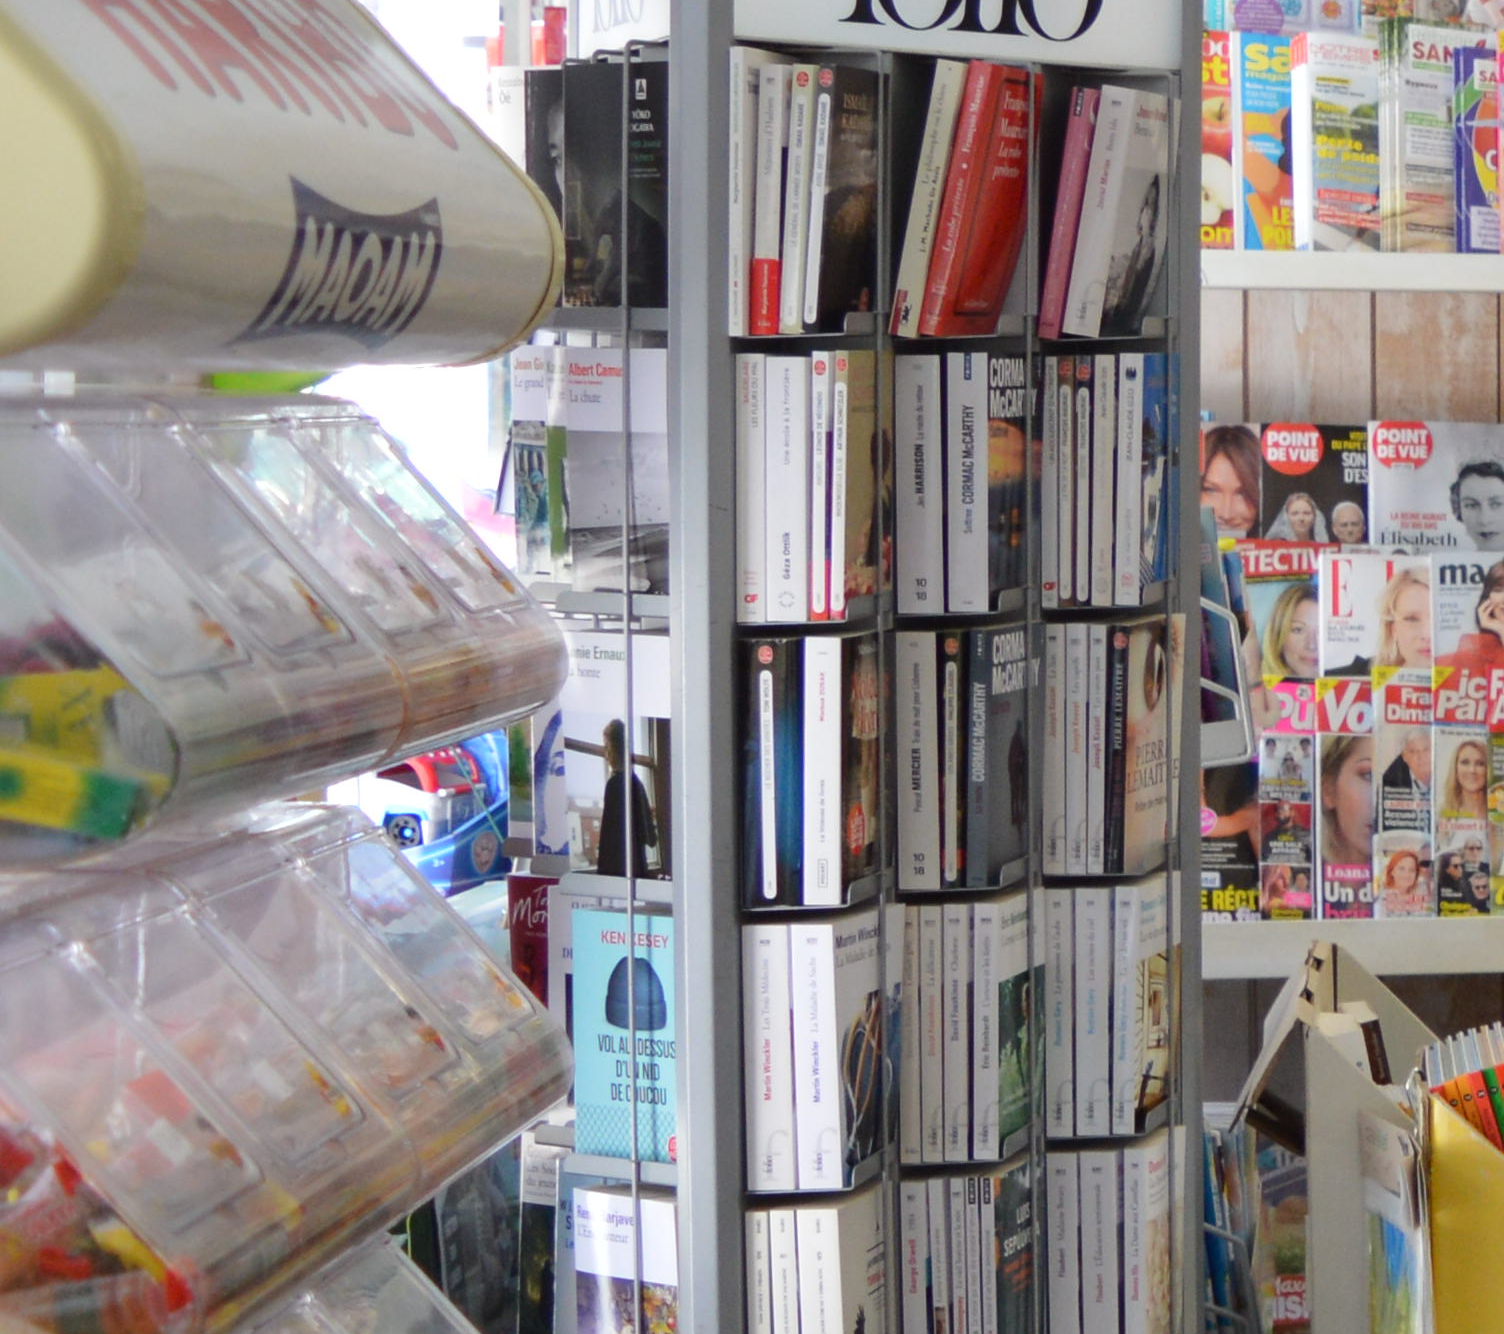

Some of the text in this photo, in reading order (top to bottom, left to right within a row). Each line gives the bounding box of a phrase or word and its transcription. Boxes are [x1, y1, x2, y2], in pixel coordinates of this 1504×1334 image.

[259, 217, 436, 331] MAOAM
[1267, 431, 1318, 447] POINT
[1376, 427, 1428, 444] POINT
[962, 404, 975, 505] CORMAC McCARTHY
[1268, 447, 1319, 462] DE VUE
[1377, 445, 1428, 459] DE VUE
[914, 443, 925, 495] HARRISON
[1380, 529, 1458, 547] Élisabeth
[972, 681, 986, 783] CORMAC McCARTHY
[912, 747, 922, 795] MERCIER
[601, 931, 626, 944] KEN
[638, 1038, 676, 1059] DESSUS
[643, 1063, 660, 1081] NID
